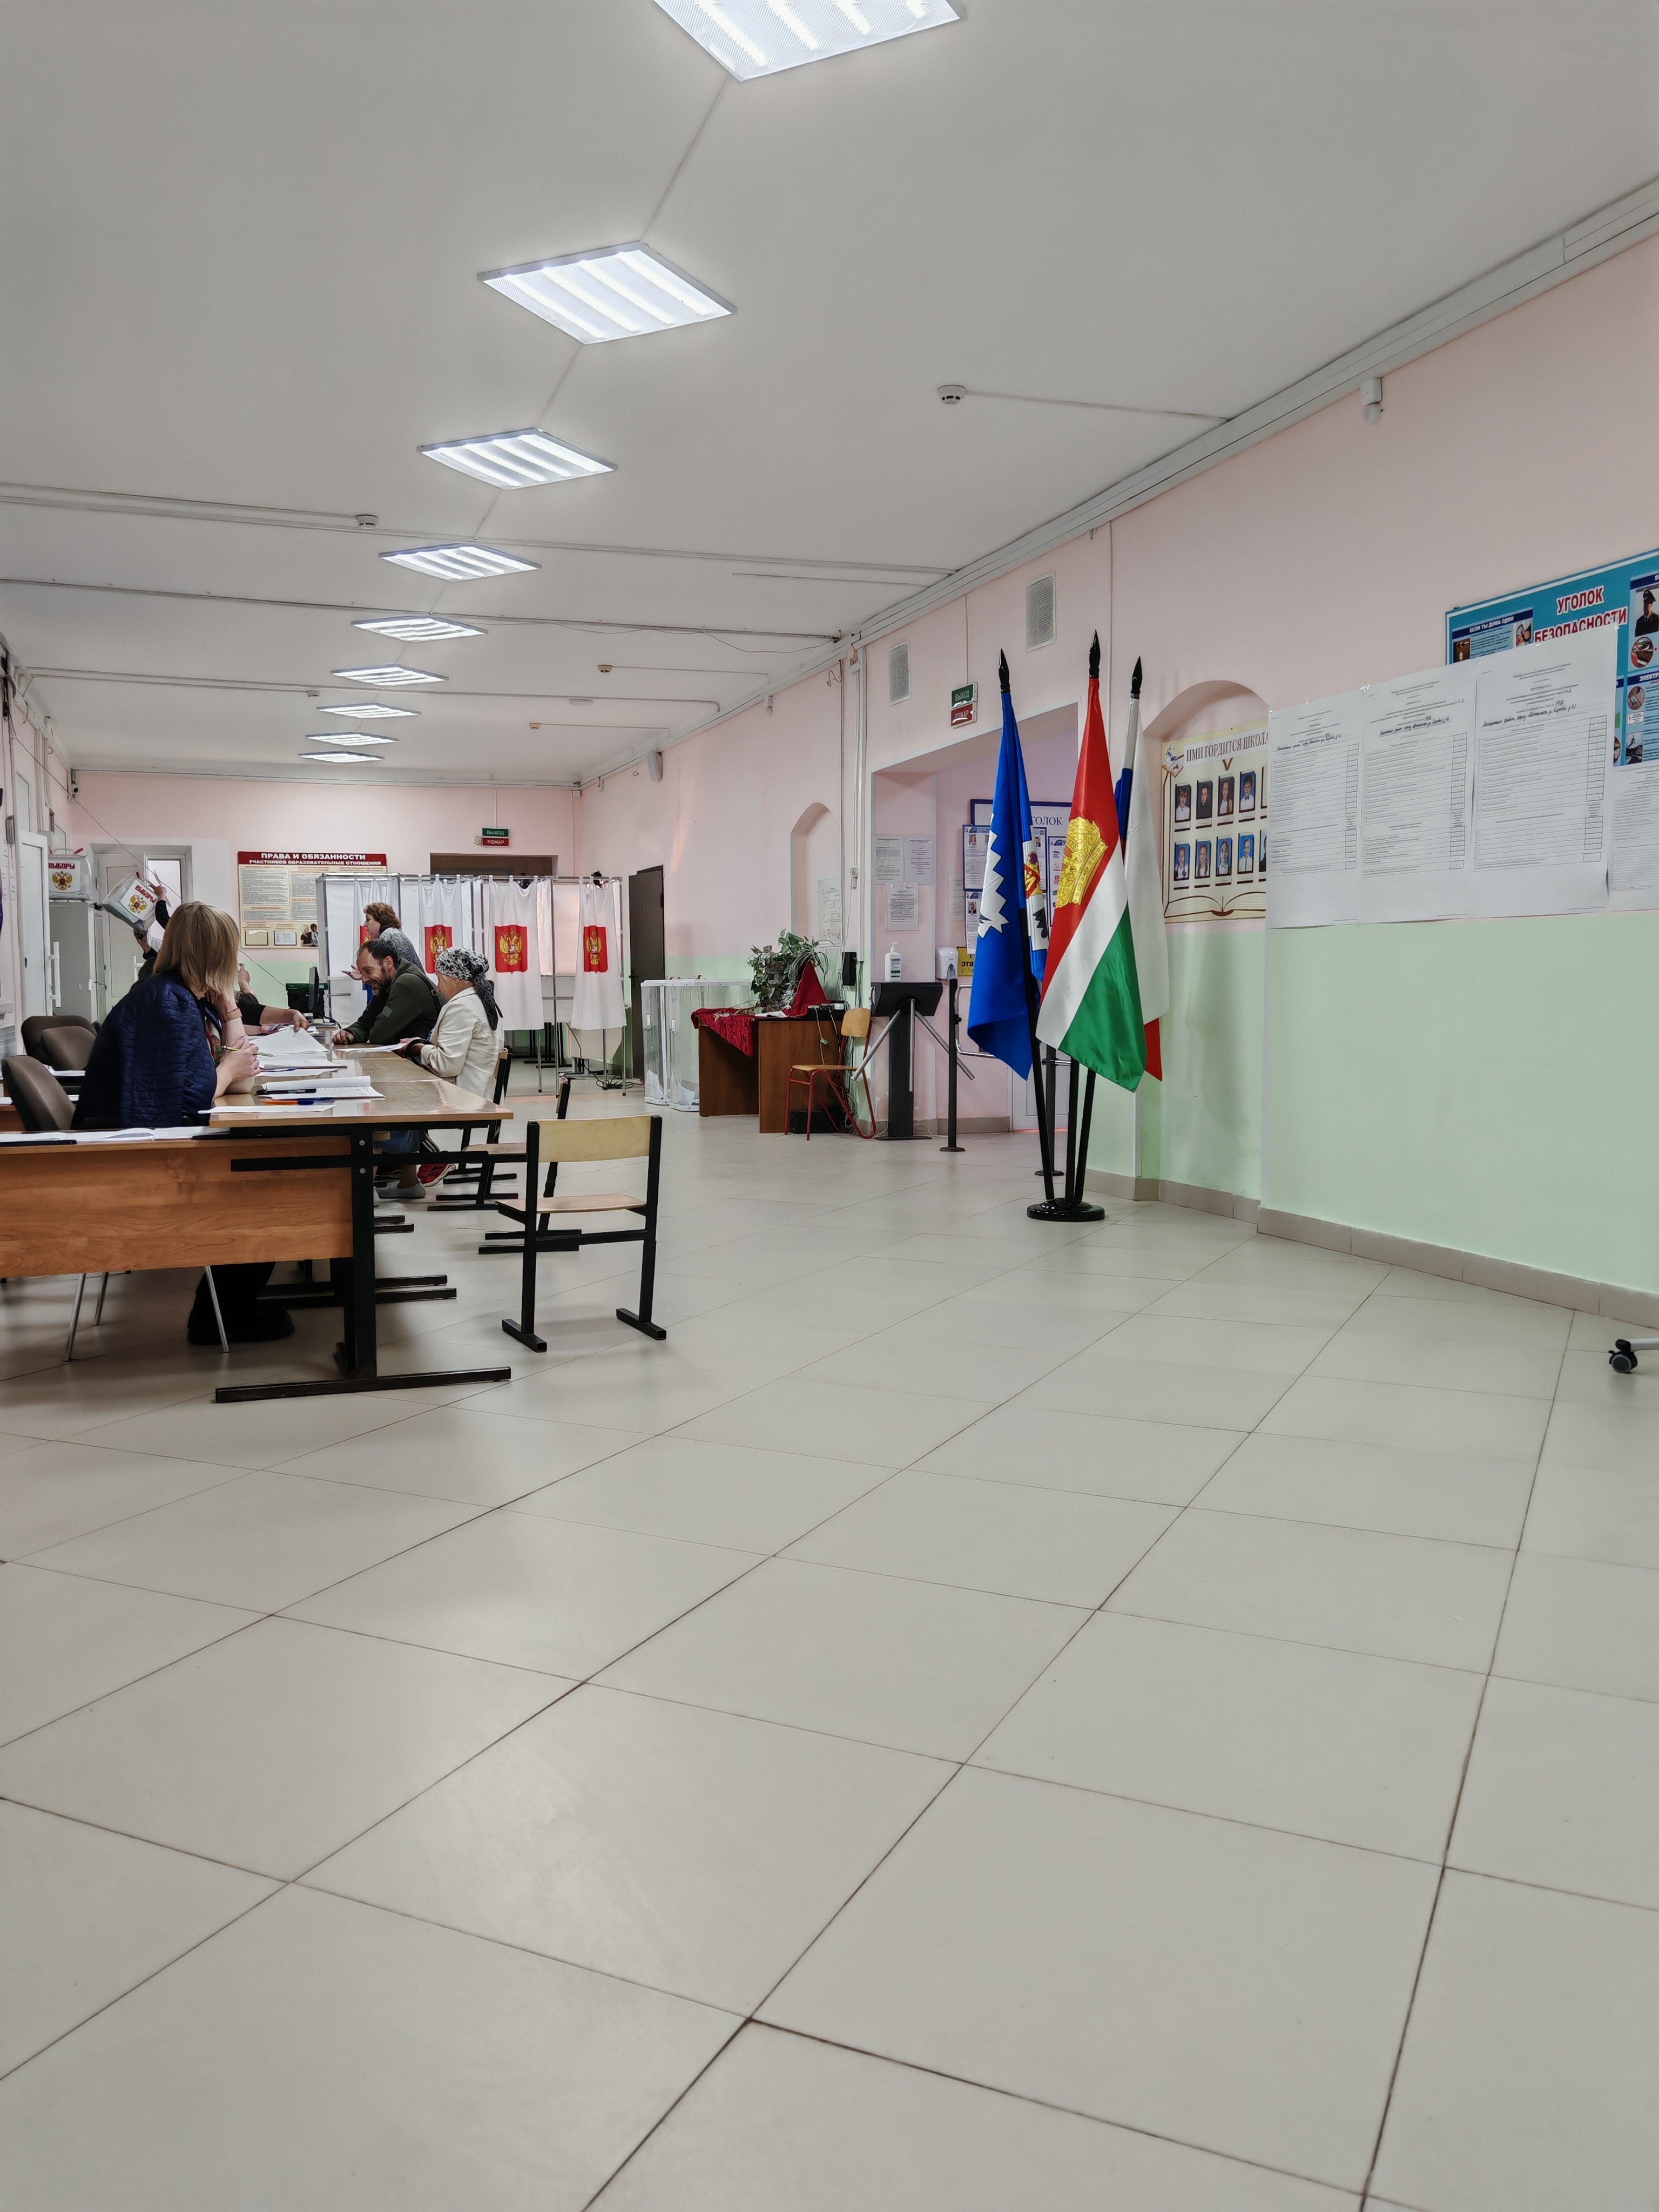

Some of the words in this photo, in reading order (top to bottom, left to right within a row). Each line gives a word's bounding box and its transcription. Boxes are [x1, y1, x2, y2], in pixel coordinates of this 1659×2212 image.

[1557, 586, 1603, 614] УГОЛОК
[1501, 616, 1514, 624] ОДИН
[1535, 608, 1627, 643] БЕЗОПАСНОСТИ
[955, 690, 969, 701] ВЫХОД
[1186, 747, 1204, 762] ИМИ
[1204, 737, 1242, 758] ГОРДИТСЯ
[134, 885, 157, 903] ВЫБОРЫ
